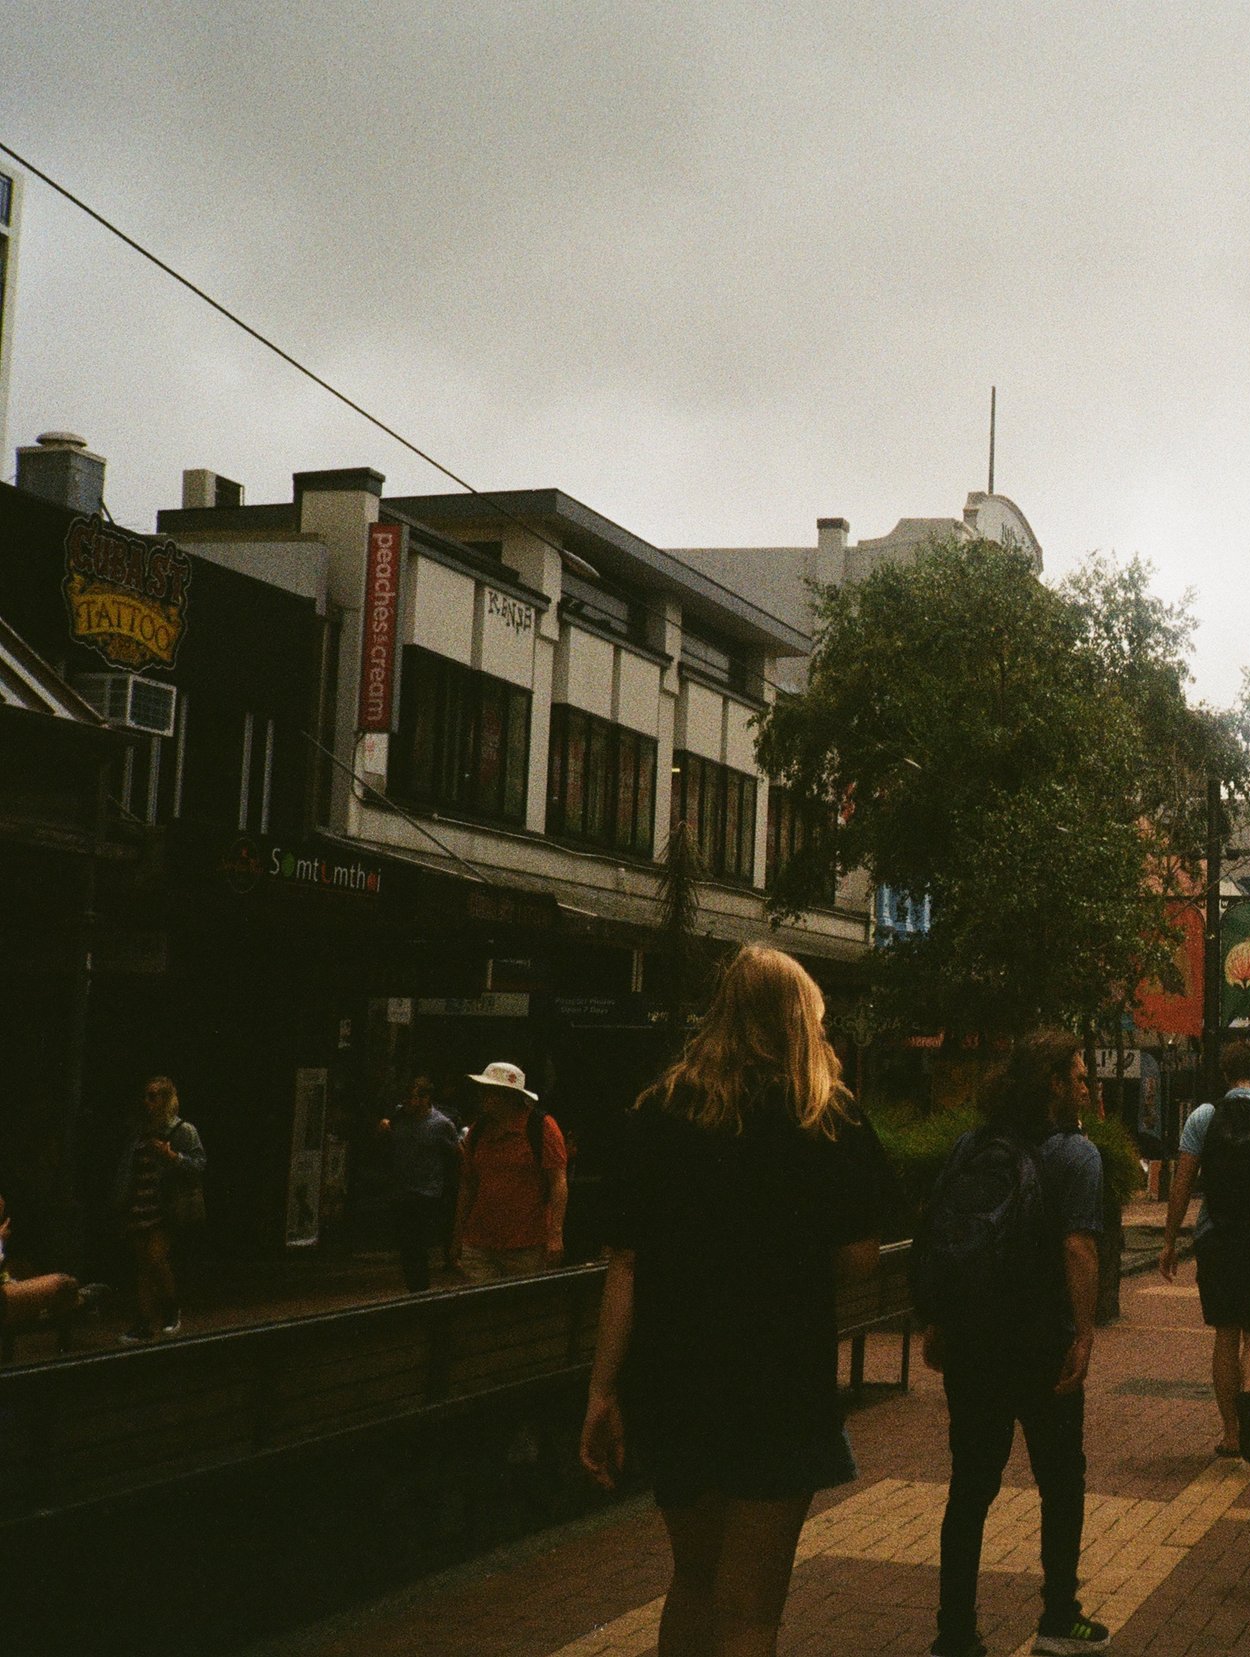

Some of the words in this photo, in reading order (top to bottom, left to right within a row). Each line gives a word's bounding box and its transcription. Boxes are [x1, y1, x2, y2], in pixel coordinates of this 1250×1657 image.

[69, 525, 146, 591] CUBA
[147, 554, 189, 603] ST
[76, 600, 171, 651] TATTOO
[366, 645, 388, 722] cream
